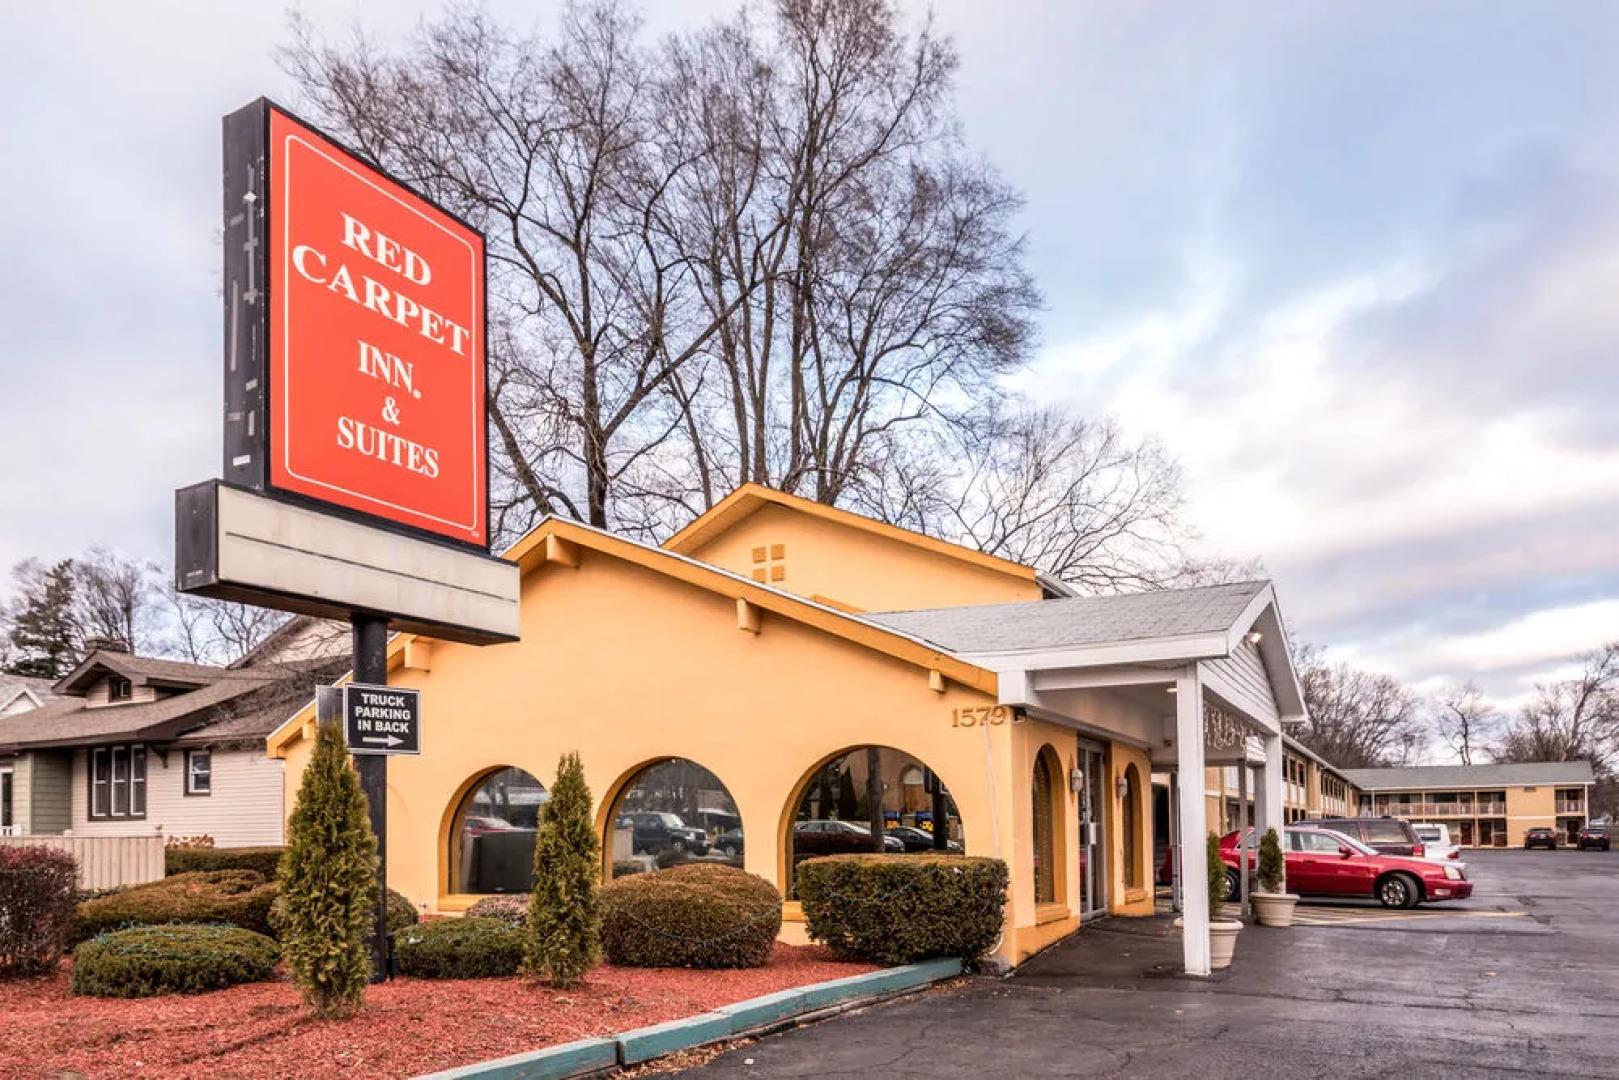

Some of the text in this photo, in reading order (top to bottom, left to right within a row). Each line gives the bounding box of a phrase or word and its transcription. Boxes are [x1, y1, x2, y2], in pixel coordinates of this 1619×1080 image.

[341, 212, 432, 286] RED
[292, 245, 470, 356] CARPET
[381, 396, 401, 426] &
[337, 416, 440, 479] SUITES
[360, 692, 406, 707] TRUCK
[354, 706, 411, 720] PARKING
[357, 719, 409, 733] IN BACK
[951, 705, 1007, 728] 1579
